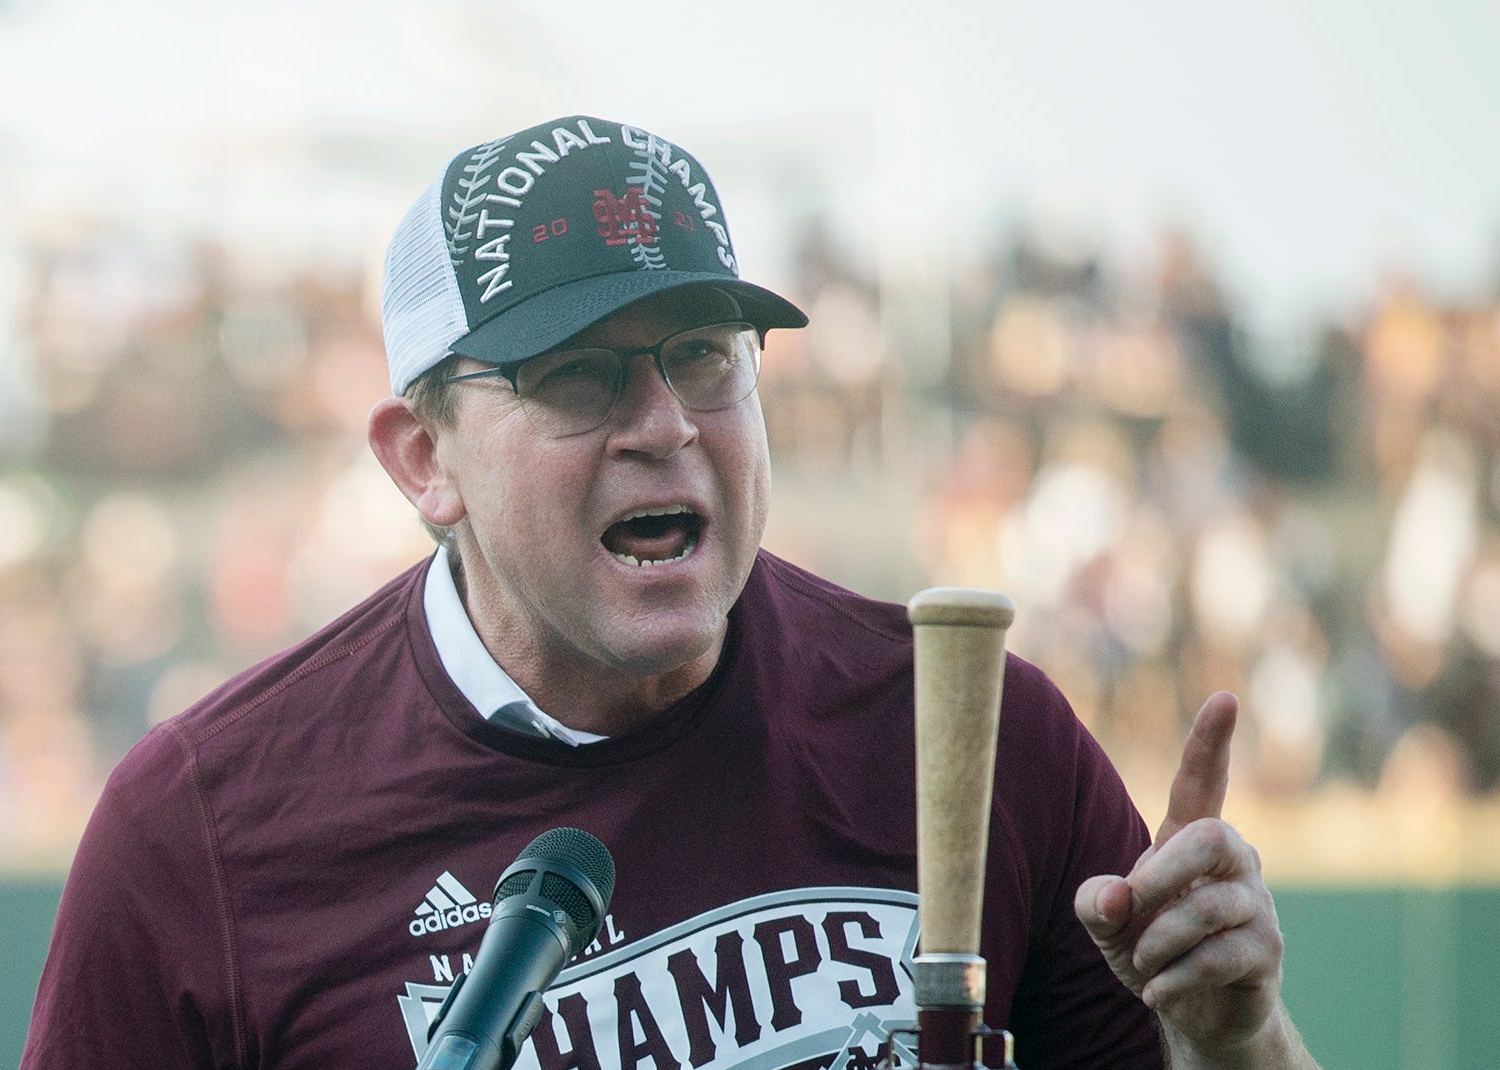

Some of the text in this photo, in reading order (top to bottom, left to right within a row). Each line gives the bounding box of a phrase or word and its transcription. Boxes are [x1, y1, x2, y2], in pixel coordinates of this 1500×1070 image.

[475, 119, 611, 304] NATIONAL
[532, 217, 568, 243] 20
[408, 902, 493, 937] adidas
